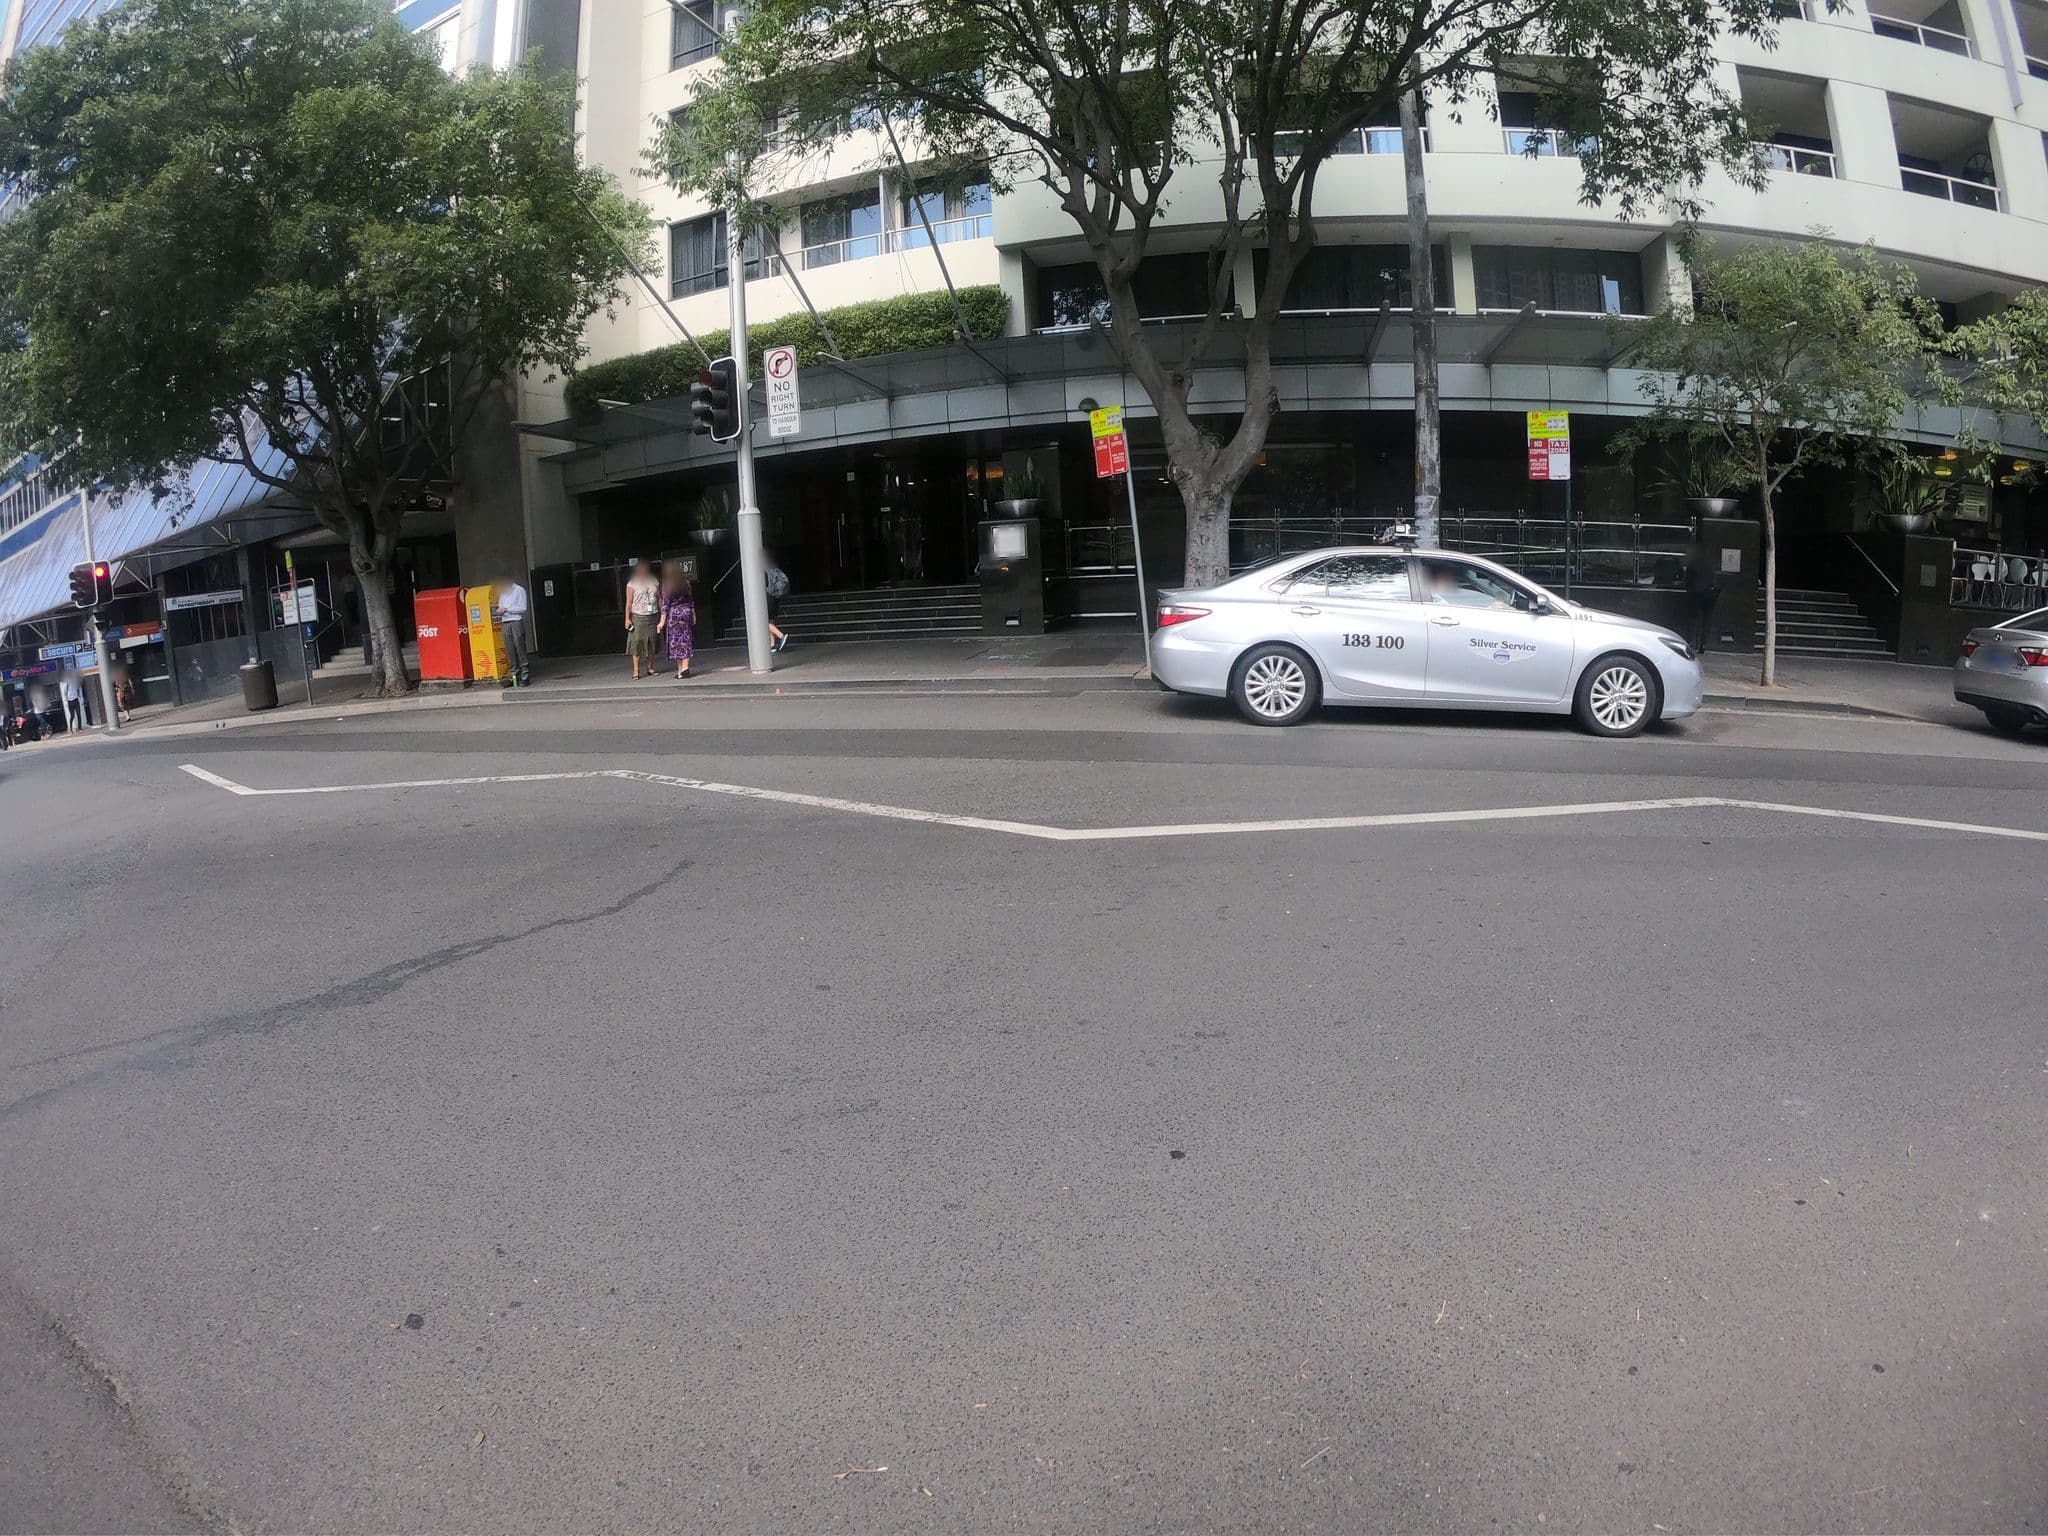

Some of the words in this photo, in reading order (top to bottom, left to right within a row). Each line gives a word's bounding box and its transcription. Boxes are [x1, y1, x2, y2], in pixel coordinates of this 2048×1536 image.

[773, 381, 791, 392] NO
[771, 393, 795, 403] RIGHT
[773, 402, 795, 412] TURN
[418, 627, 439, 638] POST
[458, 627, 468, 635] PO
[1342, 633, 1371, 648] 133
[1375, 635, 1405, 650] 100
[1469, 638, 1499, 649] Silver
[1500, 640, 1537, 652] Service
[47, 645, 74, 657] secure
